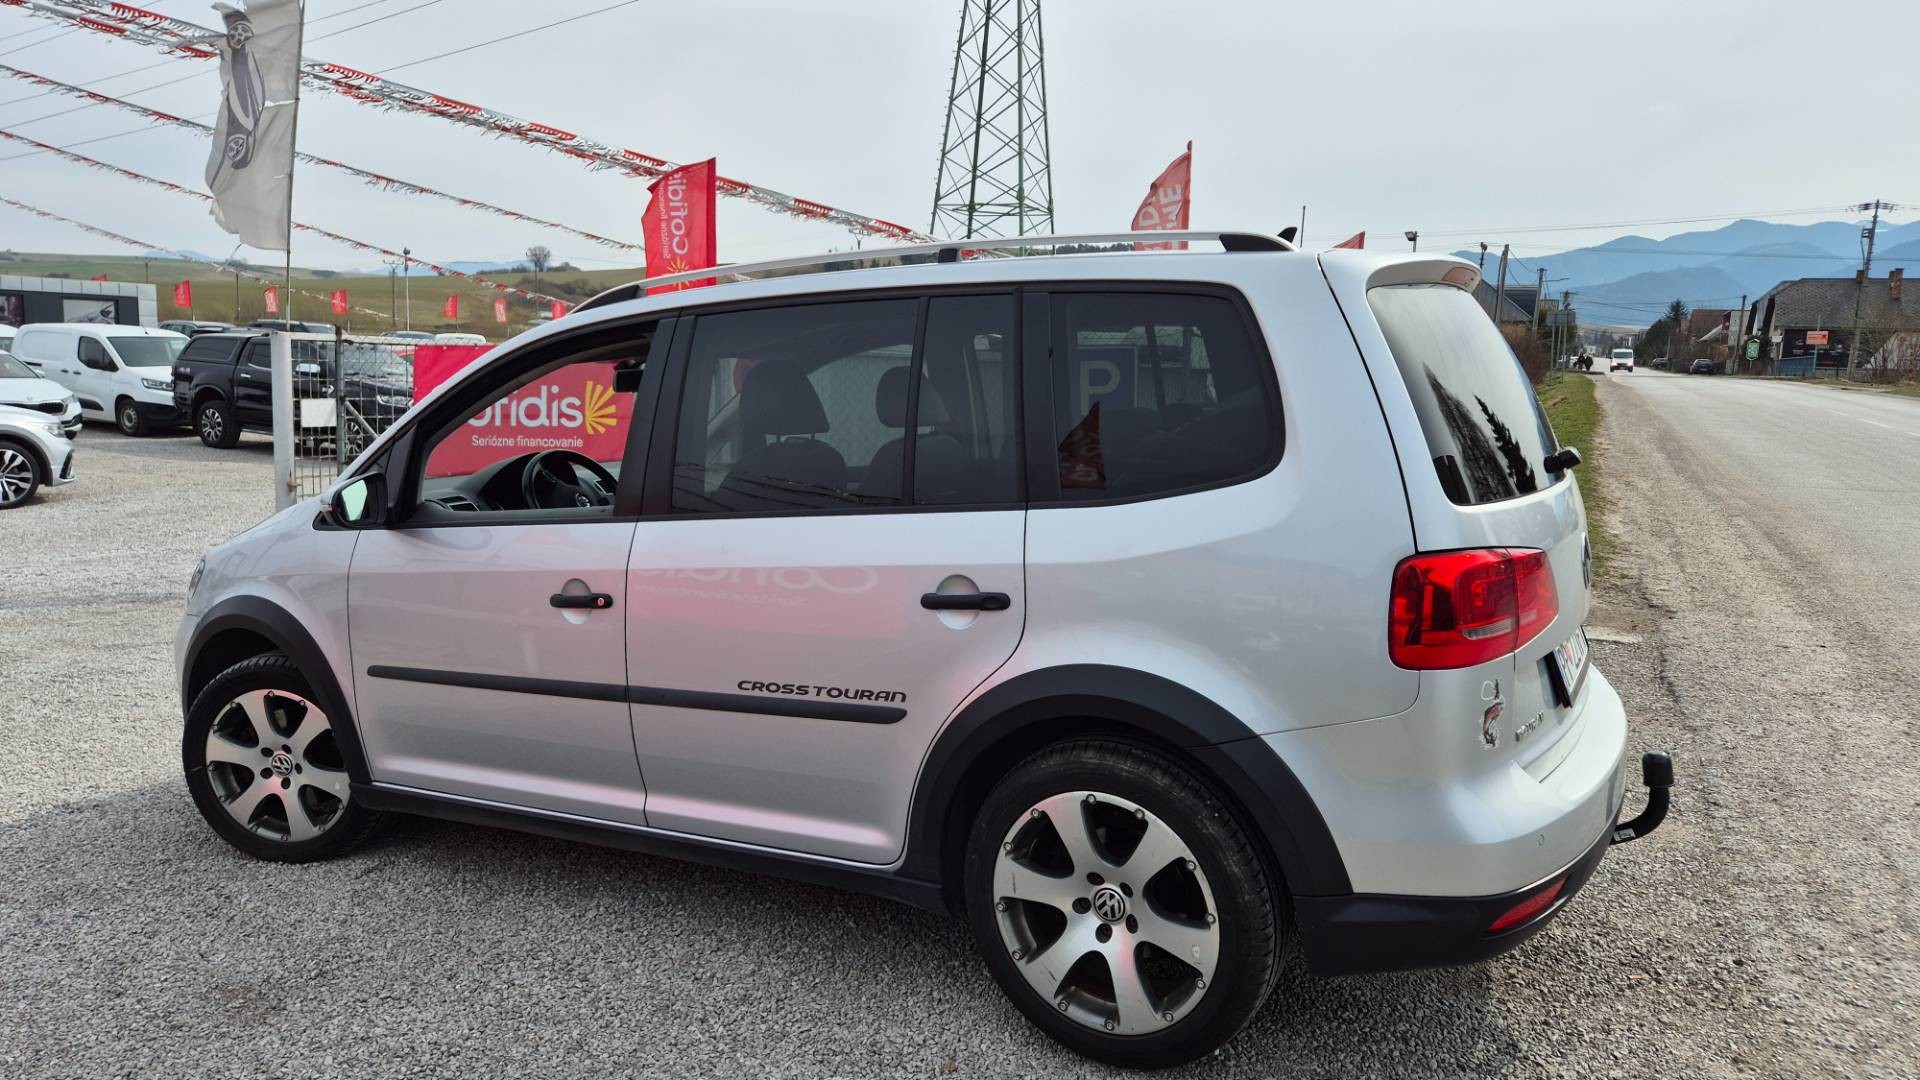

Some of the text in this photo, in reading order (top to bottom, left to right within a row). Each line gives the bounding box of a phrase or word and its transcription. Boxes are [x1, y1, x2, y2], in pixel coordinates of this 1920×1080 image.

[1079, 360, 1121, 416] P
[467, 384, 584, 428] ofidis
[471, 434, 584, 448] Seriózne financovanie
[737, 680, 907, 703] CROSS TOURAN
